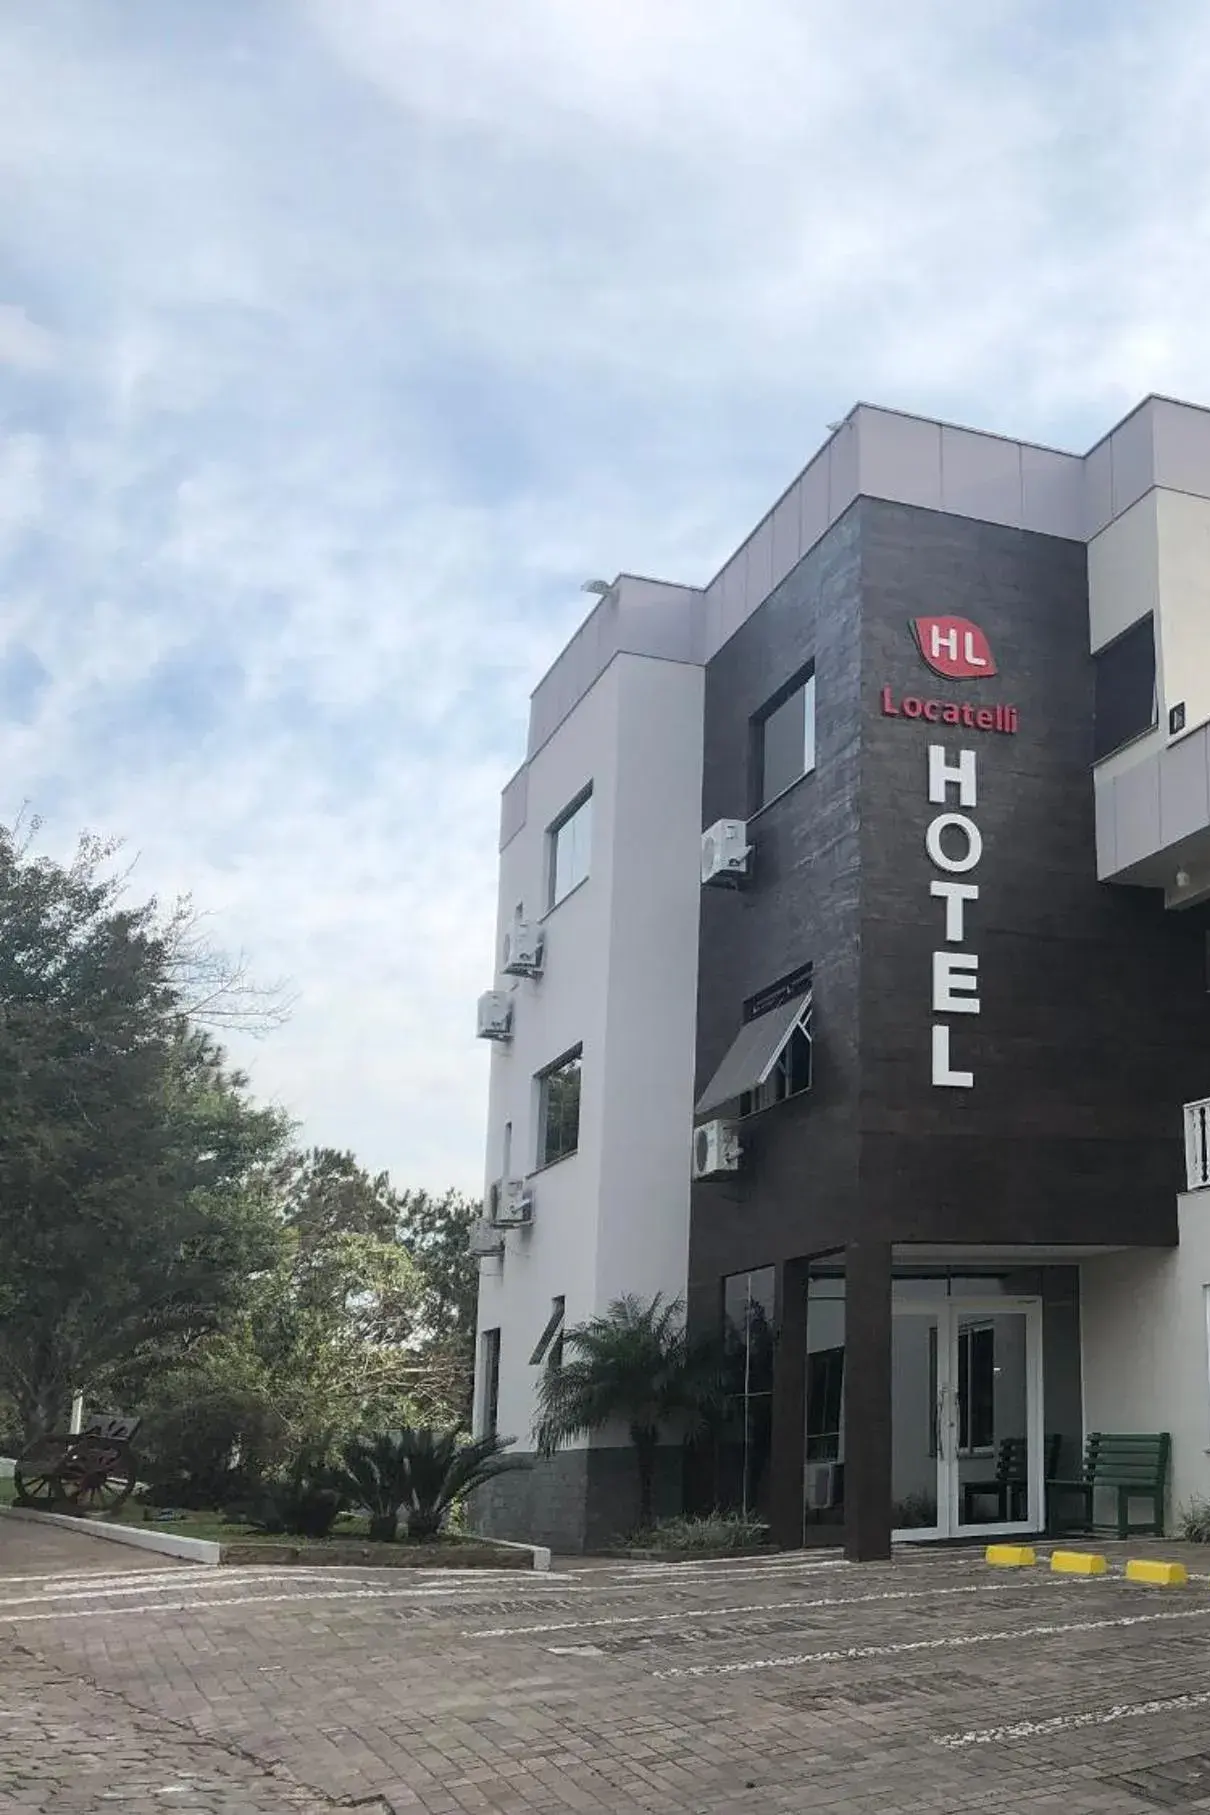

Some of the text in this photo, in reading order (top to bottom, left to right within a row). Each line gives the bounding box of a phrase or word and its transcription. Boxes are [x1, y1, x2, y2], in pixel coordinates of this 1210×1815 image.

[930, 624, 987, 666] HL
[882, 682, 1019, 734] Locatelli
[925, 744, 984, 1089] HOTEL
